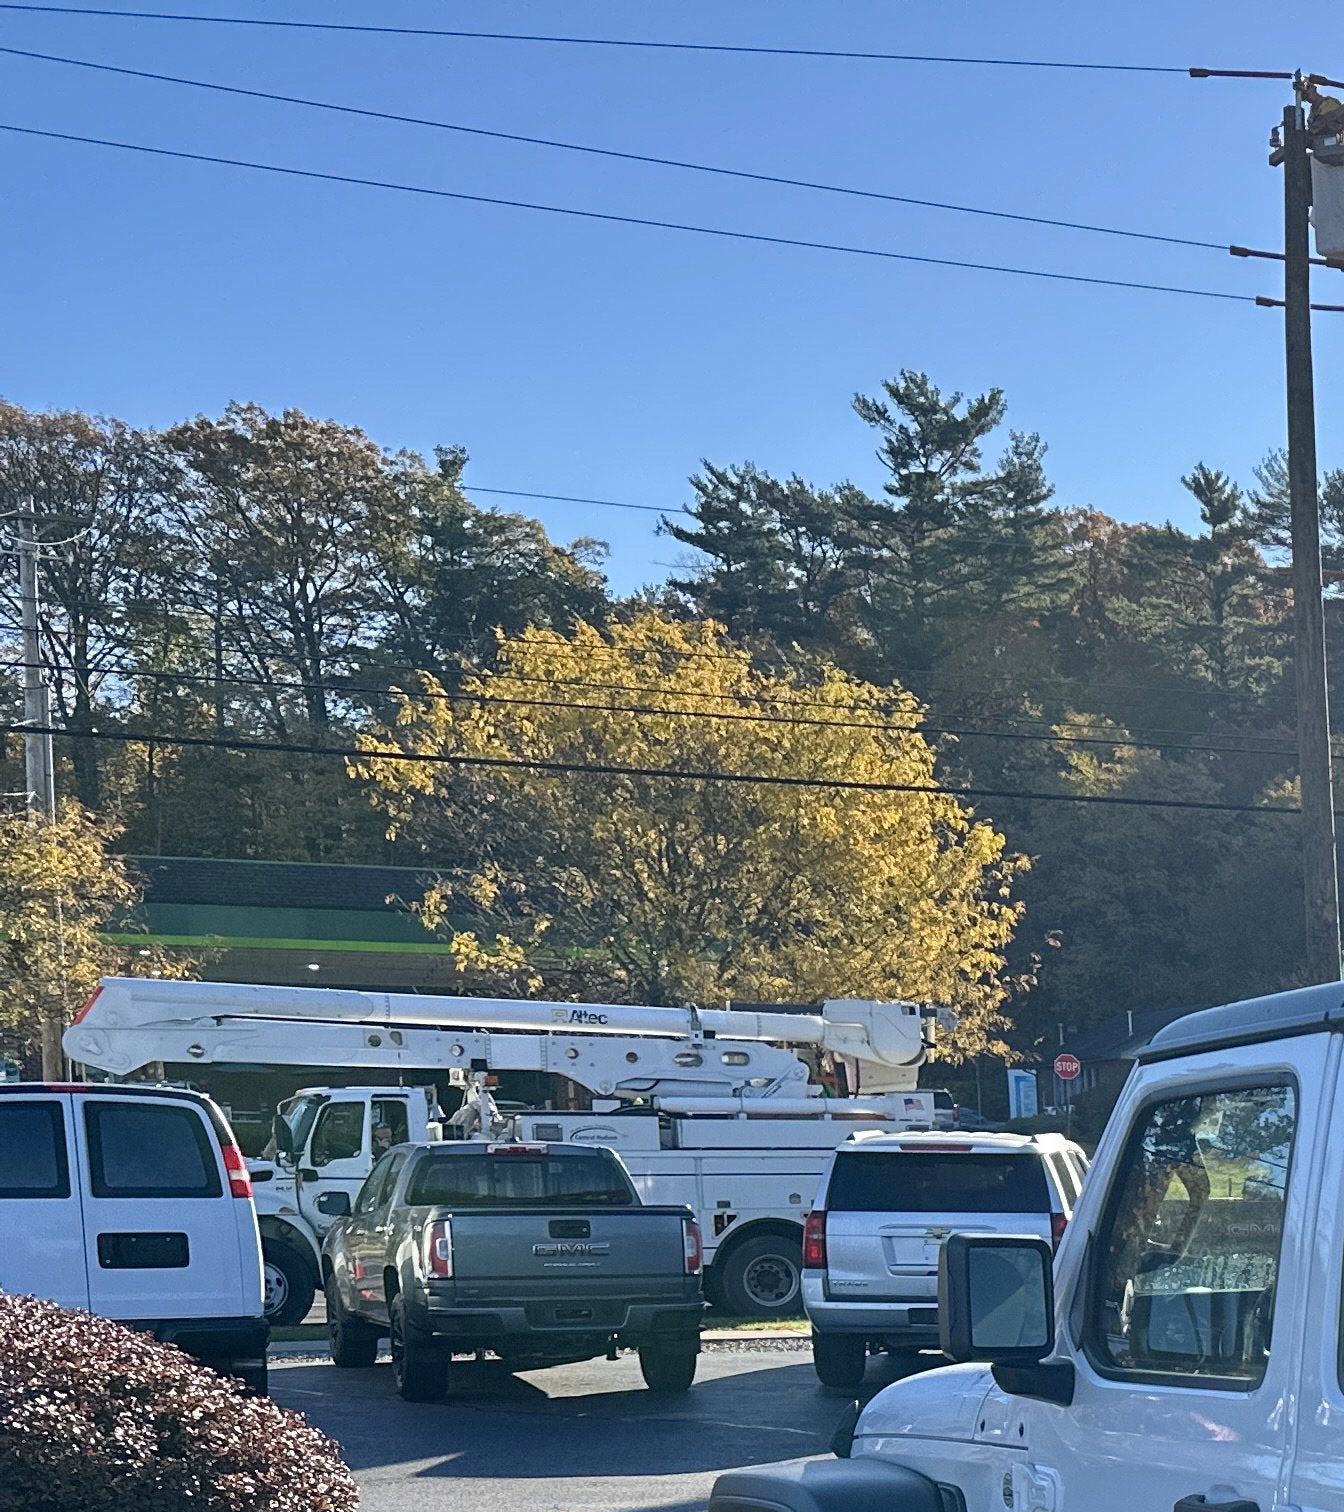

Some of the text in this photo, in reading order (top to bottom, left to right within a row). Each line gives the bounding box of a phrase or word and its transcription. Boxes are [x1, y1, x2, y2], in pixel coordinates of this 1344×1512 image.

[569, 1009, 609, 1025] Altec
[1056, 1061, 1079, 1072] STOP
[532, 1243, 610, 1257] GMC
